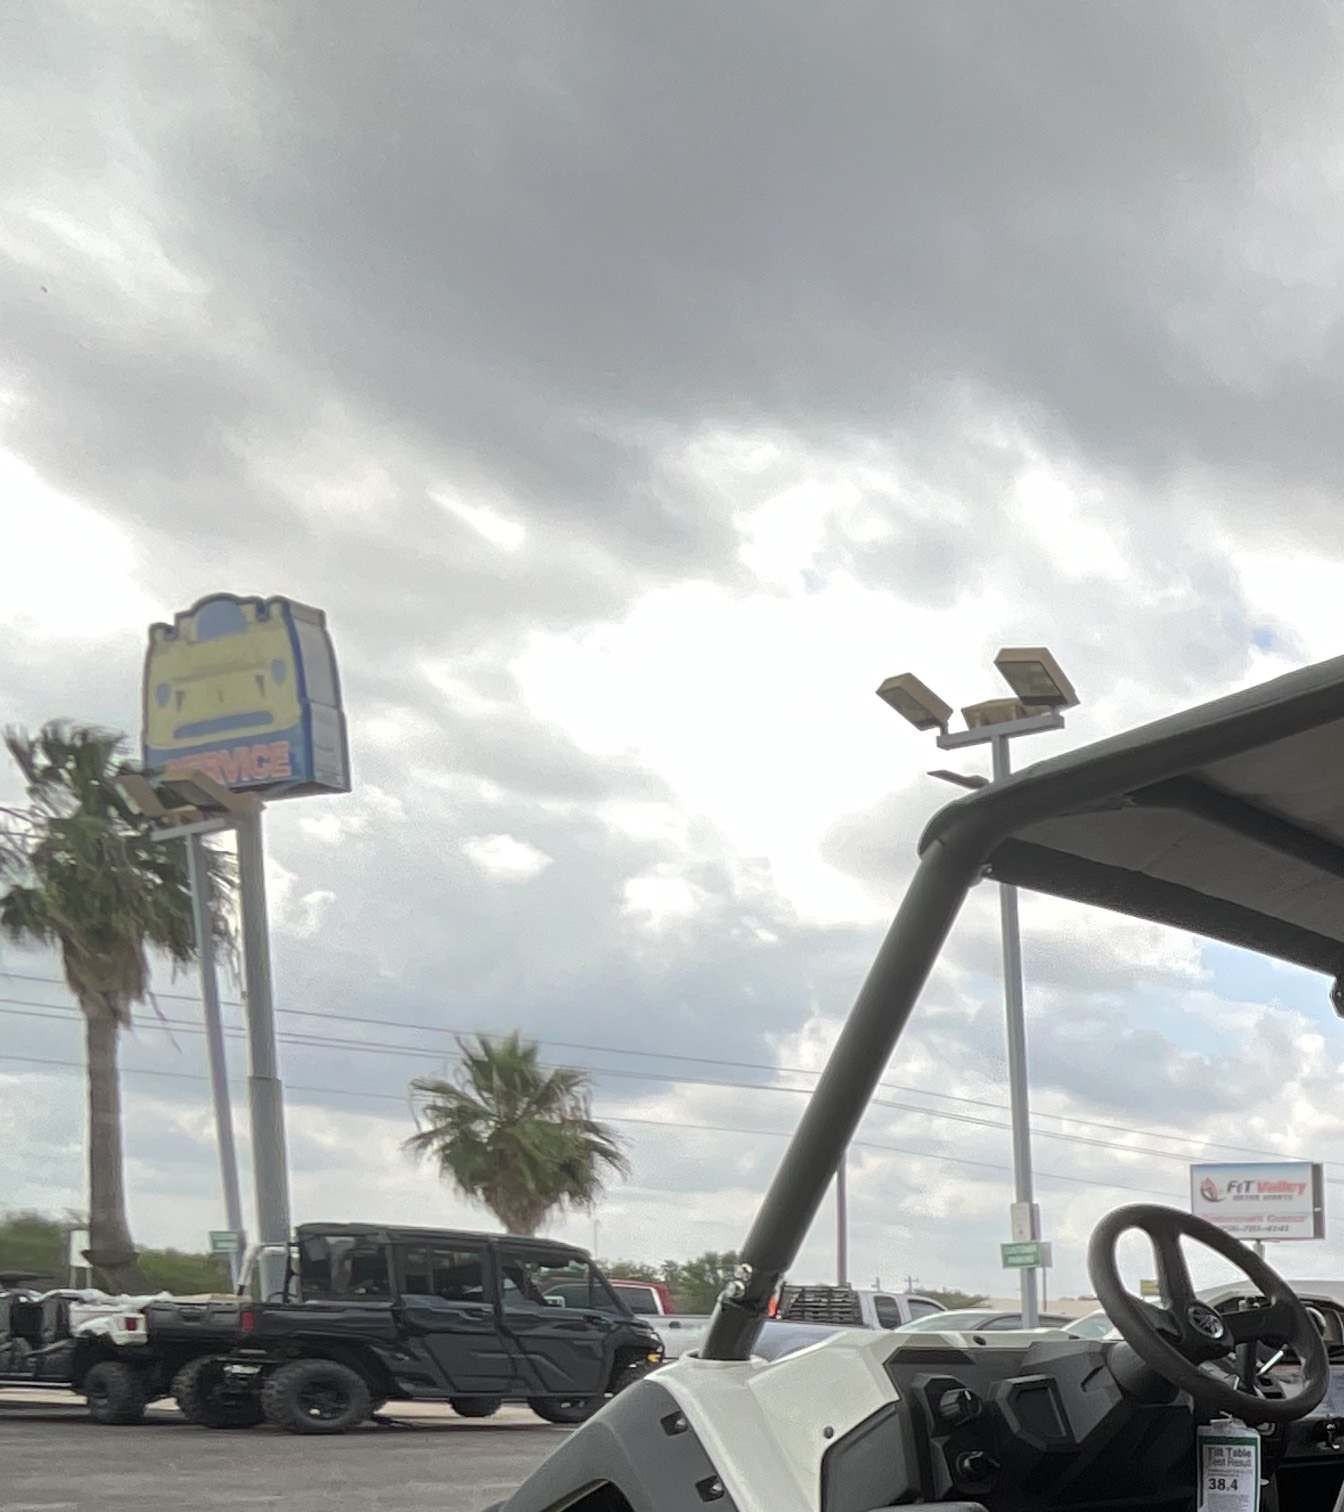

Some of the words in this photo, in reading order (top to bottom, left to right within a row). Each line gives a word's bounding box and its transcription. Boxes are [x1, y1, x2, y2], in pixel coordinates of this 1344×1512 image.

[165, 740, 292, 786] RVICE
[1256, 1178, 1308, 1196] Valley
[1225, 1447, 1252, 1458] Table
[1208, 1478, 1238, 1491] 38.4
